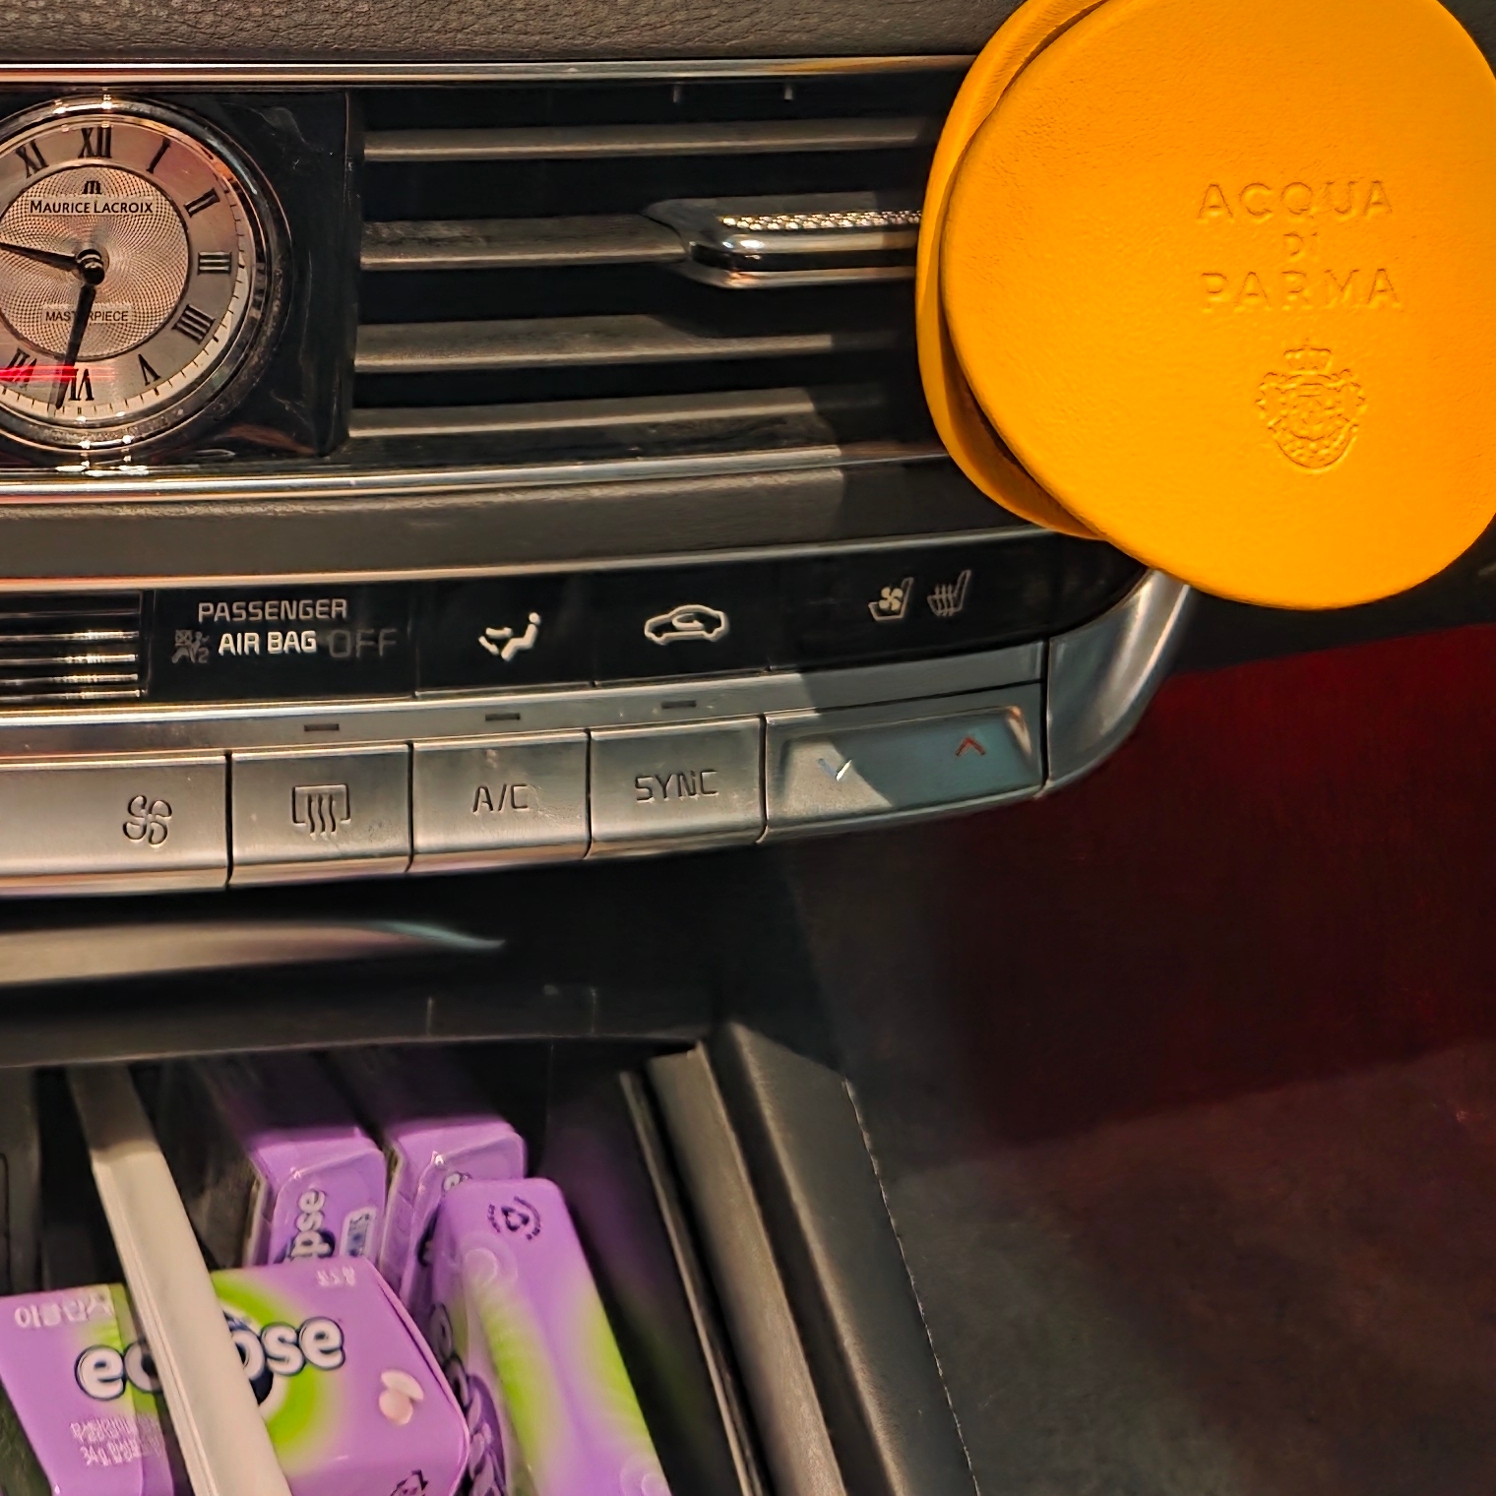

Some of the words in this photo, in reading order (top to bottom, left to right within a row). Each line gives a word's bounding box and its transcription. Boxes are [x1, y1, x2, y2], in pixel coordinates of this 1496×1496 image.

[30, 199, 91, 215] MAURICE
[93, 199, 154, 215] LACROIX
[1196, 179, 1394, 222] ACQUA
[1200, 267, 1402, 312] PARMA
[45, 310, 129, 322] MASRPIECE
[198, 598, 347, 623] PASSENGER
[218, 632, 260, 655] AIR
[267, 630, 317, 654] BAG
[328, 628, 397, 658] OFF
[472, 784, 529, 814] A/C
[635, 769, 718, 802] SYNC
